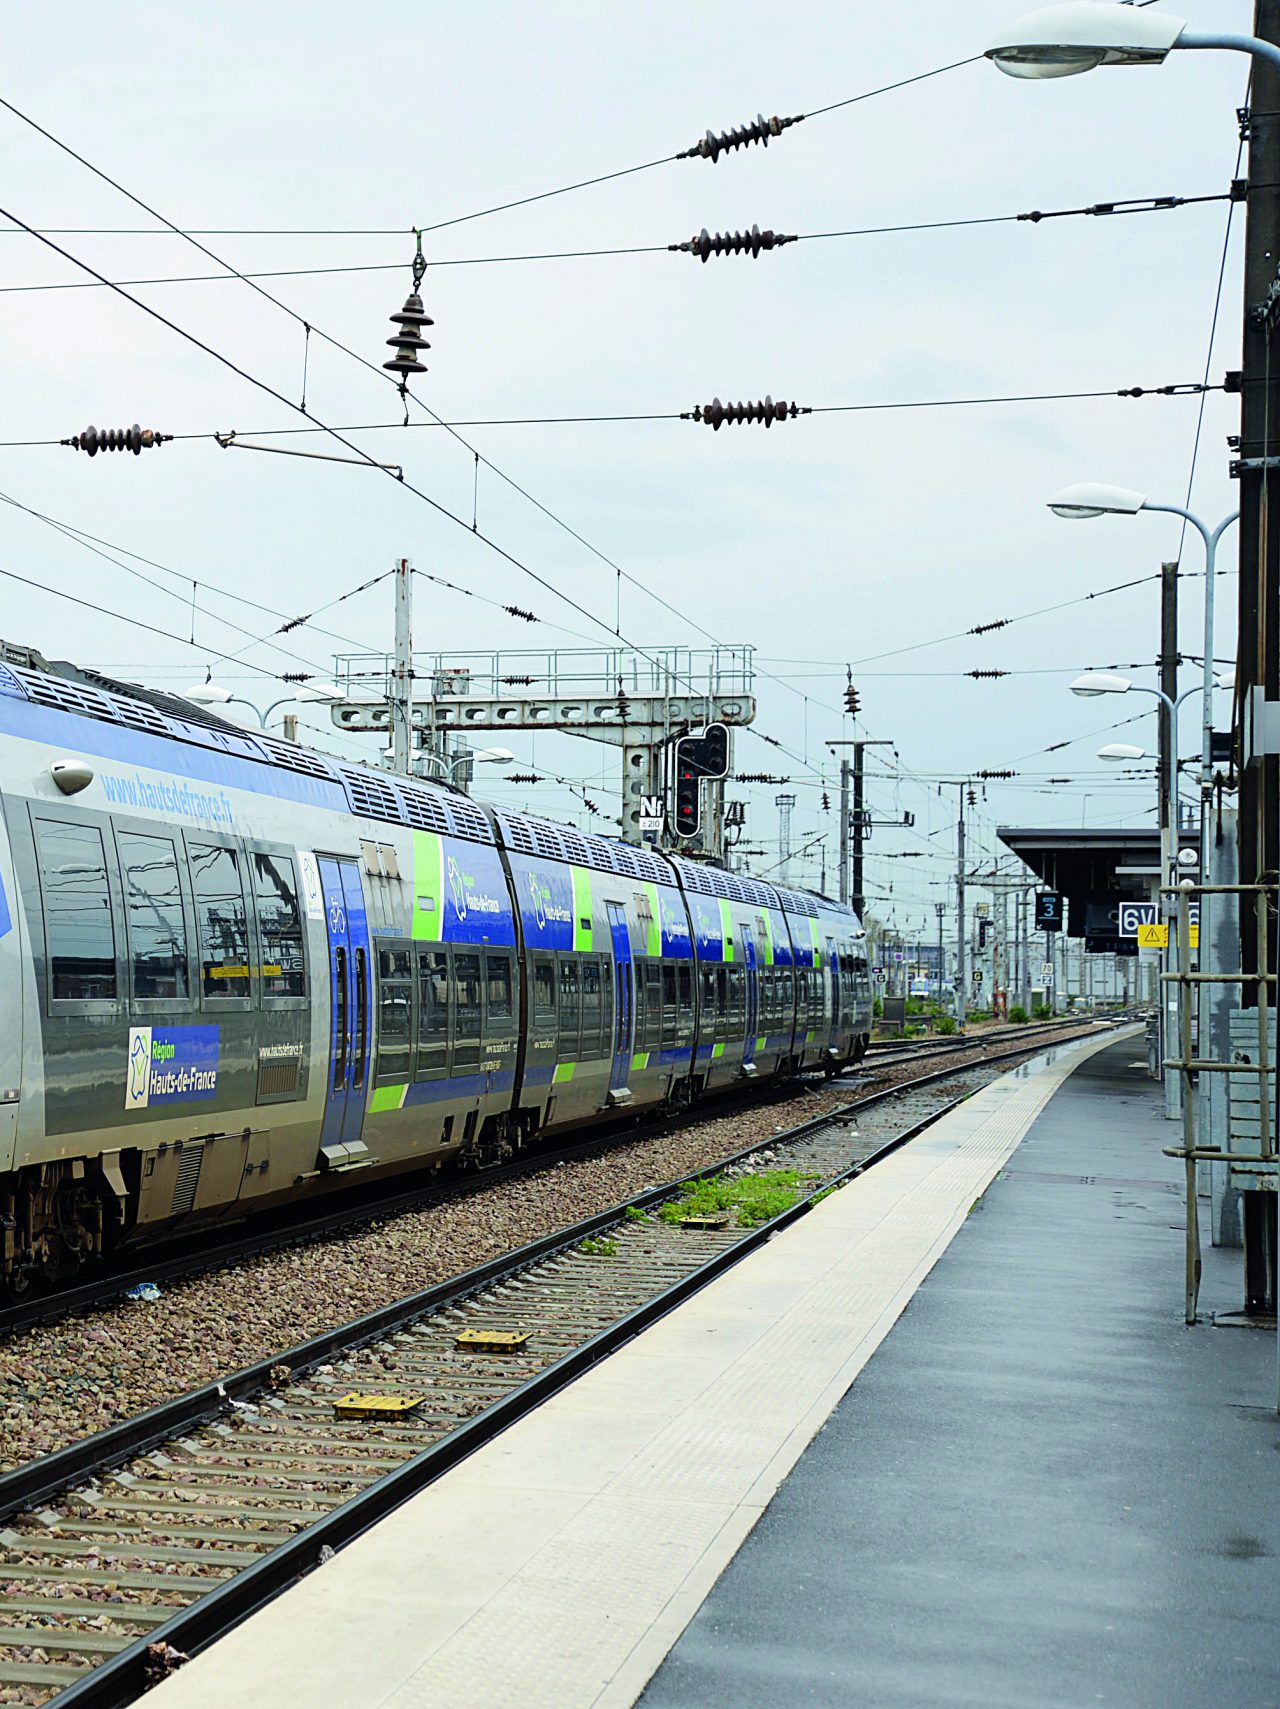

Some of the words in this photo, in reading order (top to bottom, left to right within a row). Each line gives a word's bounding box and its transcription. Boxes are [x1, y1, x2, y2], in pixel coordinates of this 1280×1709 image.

[100, 773, 233, 823] www.hautsdefrance.fr
[640, 796, 664, 817] Nf
[1044, 903, 1054, 917] 3
[1123, 909, 1153, 931] 6V
[152, 1038, 175, 1065] Région
[149, 1066, 216, 1096] Hauts-de-France
